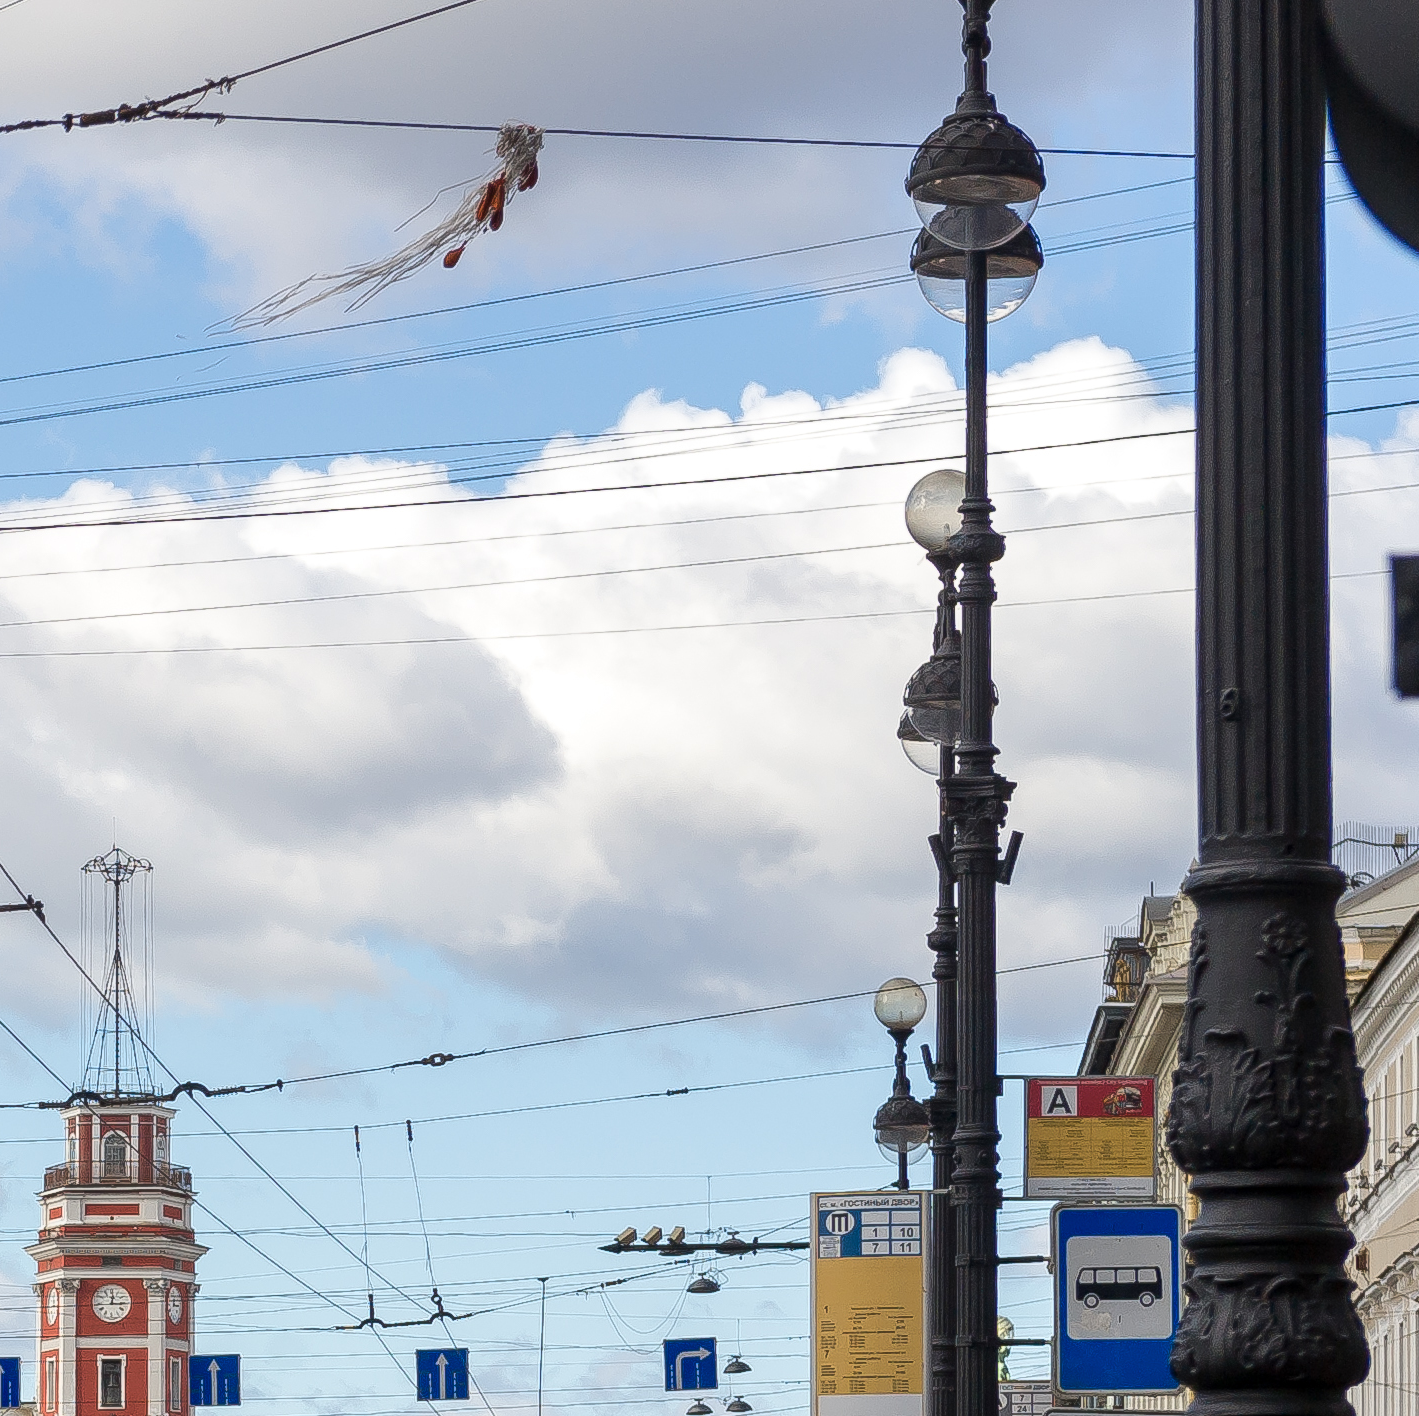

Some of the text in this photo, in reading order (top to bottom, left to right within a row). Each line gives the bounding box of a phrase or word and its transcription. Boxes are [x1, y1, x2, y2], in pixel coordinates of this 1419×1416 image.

[1047, 1088, 1072, 1114] А
[872, 1228, 878, 1237] 1
[899, 1228, 914, 1237] 10
[871, 1243, 879, 1253] 7
[899, 1243, 912, 1252] 11
[1019, 1394, 1025, 1402] 7
[1016, 1405, 1028, 1413] 24
